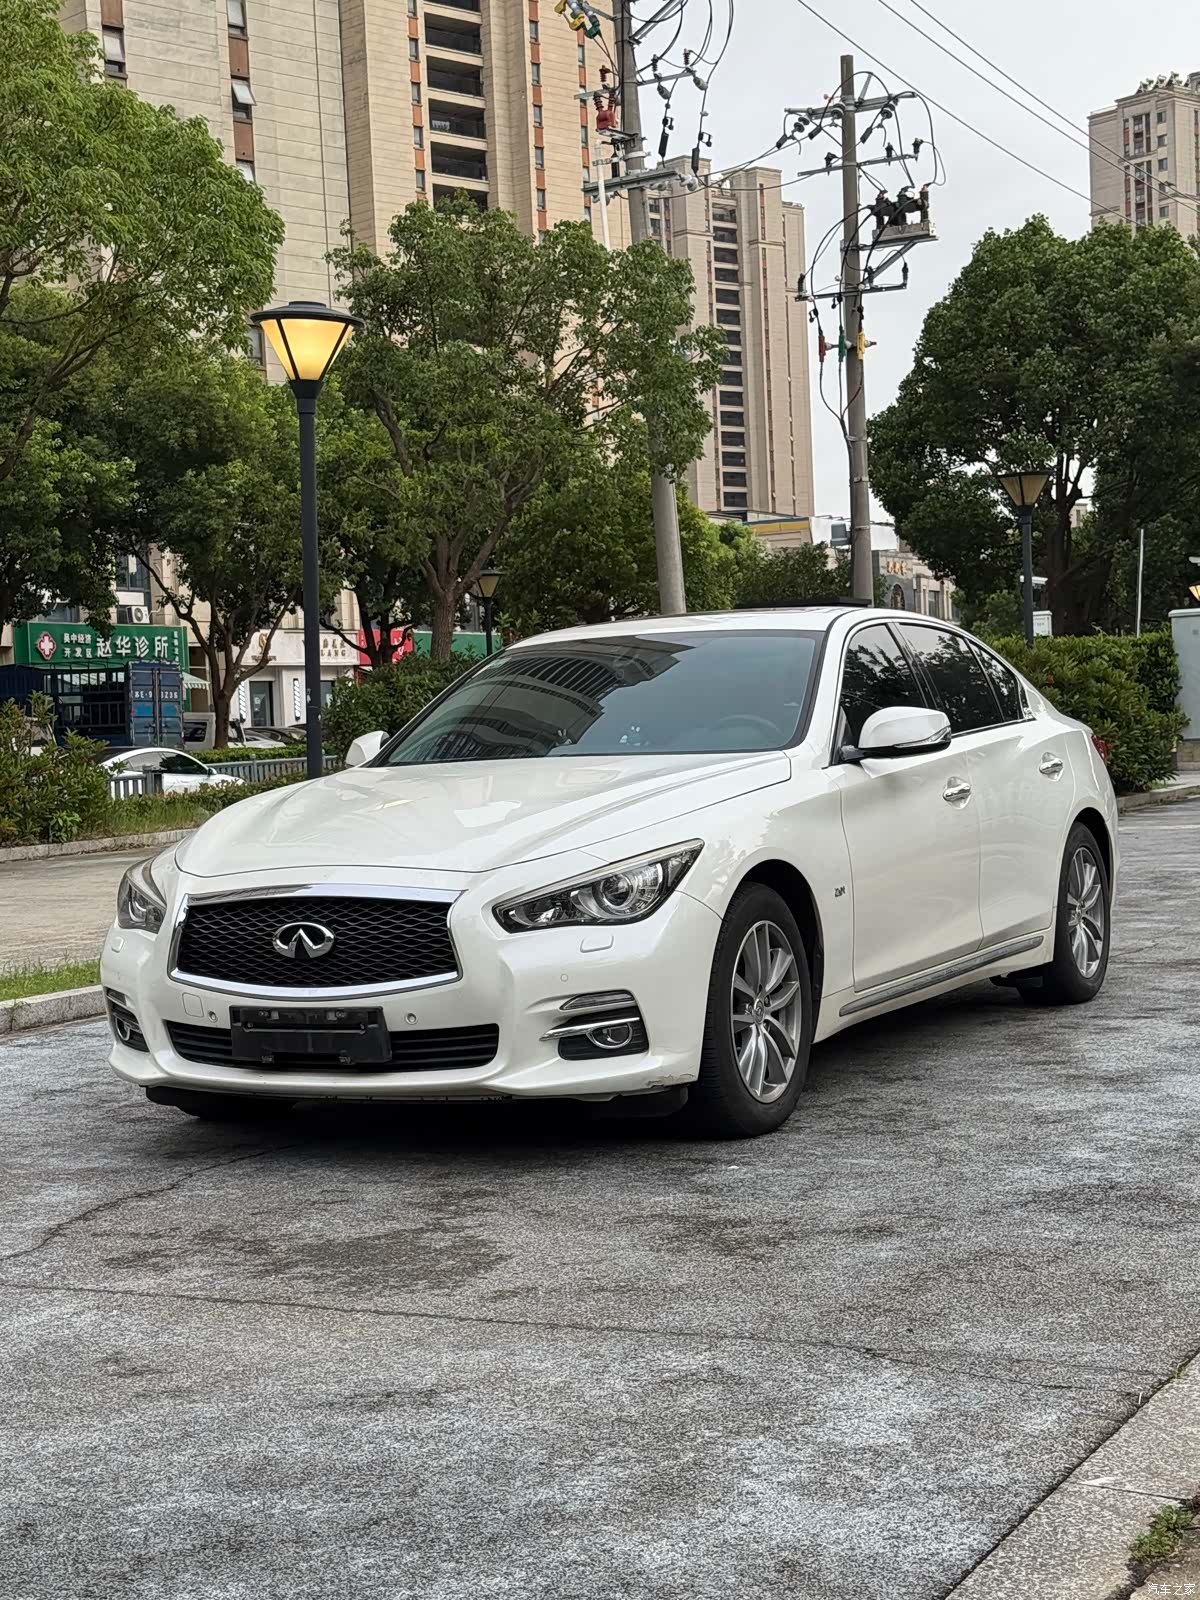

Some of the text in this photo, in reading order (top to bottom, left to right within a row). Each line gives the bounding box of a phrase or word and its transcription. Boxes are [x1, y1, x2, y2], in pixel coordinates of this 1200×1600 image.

[64, 633, 91, 643] 吴中经济
[64, 647, 92, 658] 开发区
[97, 636, 168, 658] 赵华诊所
